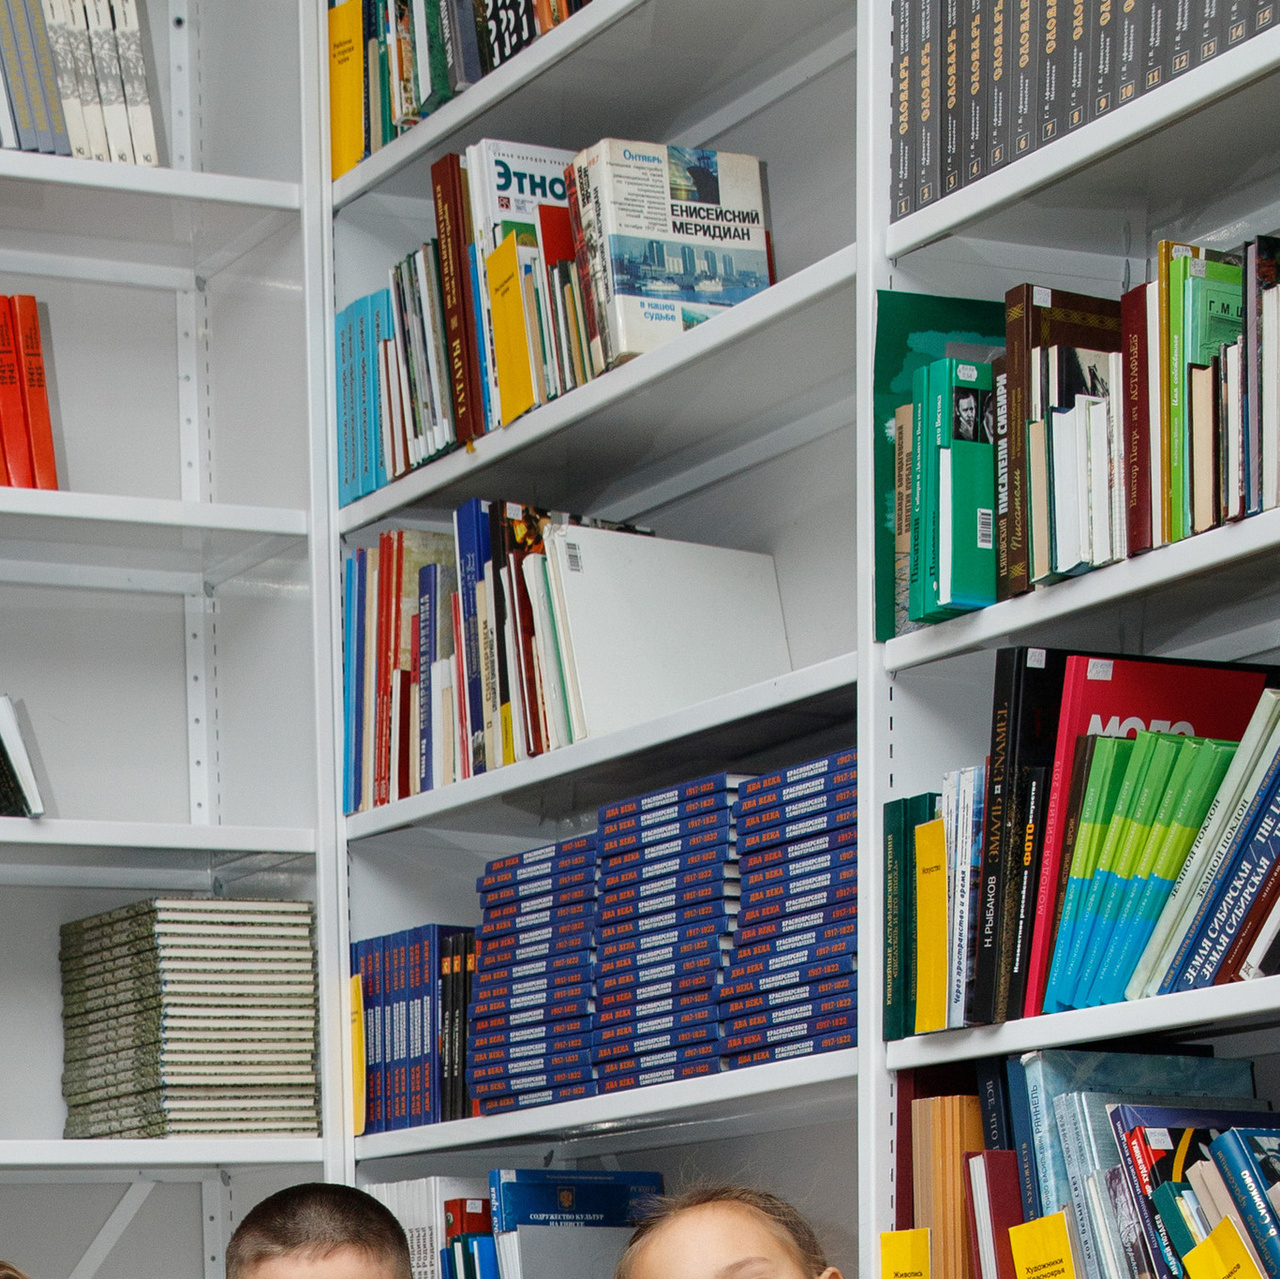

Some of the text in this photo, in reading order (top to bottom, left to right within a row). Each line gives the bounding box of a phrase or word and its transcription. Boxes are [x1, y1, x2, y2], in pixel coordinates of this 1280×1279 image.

[947, 28, 957, 109] СЛОВАРЬ
[1174, 54, 1187, 70] 12
[1046, 123, 1053, 136] 7
[949, 175, 955, 187] 3
[671, 204, 759, 224] ЕНИСЕЙСКИЙ
[672, 221, 750, 241] МЕРИДИАН
[644, 311, 676, 321] судьбе
[648, 302, 675, 311] нашей
[7, 362, 16, 384] 1945
[450, 339, 467, 417] ТАТАРЫ
[996, 373, 1007, 434] СИБИРИ
[997, 438, 1008, 513] ПИСАТЕЛИ
[419, 594, 429, 729] СИБИРСКАЯ АРКТИКА
[641, 790, 678, 805] КРАСНОЯРСКОГО
[685, 781, 714, 796] 1917-1822
[605, 803, 637, 819] ДВА ВЕКА
[641, 796, 678, 810] САМОУПРАВЛЕНИЯ
[988, 796, 1002, 863] ЭМАЛЬ
[1037, 760, 1062, 914] МОЛОДАЯ СИБИРЬ 2019
[1194, 797, 1250, 900] ЗЕМНОЙ ПОКЛОН
[921, 863, 941, 874] Искусство
[1018, 869, 1029, 918] российское
[1182, 859, 1253, 985] ЗЕМЛЯ СИБИРСКАЯ
[1013, 919, 1024, 973] Неизвестное
[1030, 1084, 1051, 1209] ТОЙВО ВАСИЛЬЕВИЧ РЯННЕЛЬ
[893, 1270, 923, 1279] Живопись
[1025, 1258, 1064, 1275] Художники
